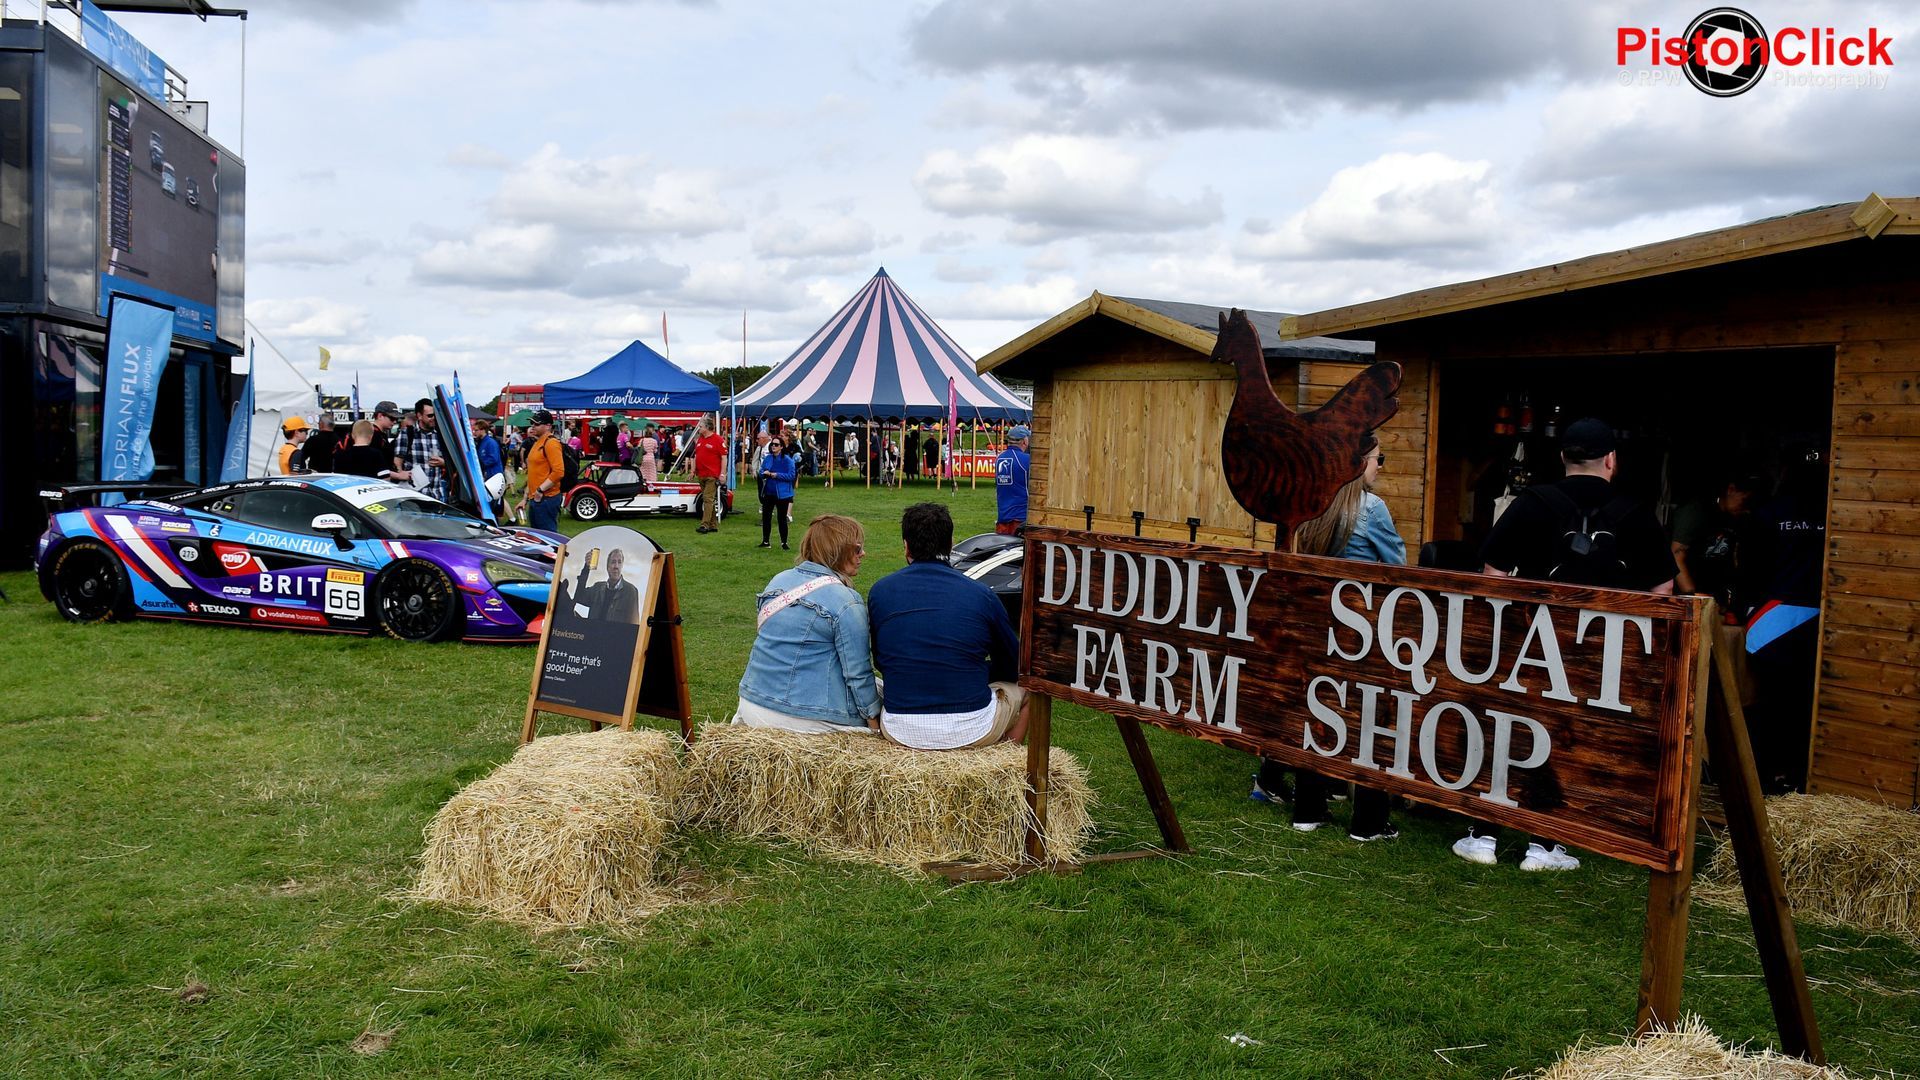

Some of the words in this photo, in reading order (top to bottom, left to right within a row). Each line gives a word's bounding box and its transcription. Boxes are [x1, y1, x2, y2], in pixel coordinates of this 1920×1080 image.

[594, 389, 670, 406] adrianflux.co.uk
[333, 412, 349, 421] PIZZA
[364, 412, 375, 421] PIZ
[1778, 521, 1810, 531] TEAM
[182, 549, 195, 559] 275
[221, 553, 245, 564] CDW
[331, 571, 361, 583] PIRELLI
[259, 573, 322, 597] BRIT
[329, 589, 360, 611] 68
[200, 604, 240, 616] TEXACO
[267, 610, 296, 620] vodafone
[296, 613, 321, 622] business
[1038, 541, 1267, 642] DIDDLY
[1326, 579, 1653, 713] SQUAT
[552, 628, 585, 640] Hawkstone
[568, 655, 581, 664] me
[582, 656, 602, 667] that's
[546, 663, 566, 673] good
[1070, 624, 1246, 733] FARM
[1303, 676, 1552, 808] SHOP
